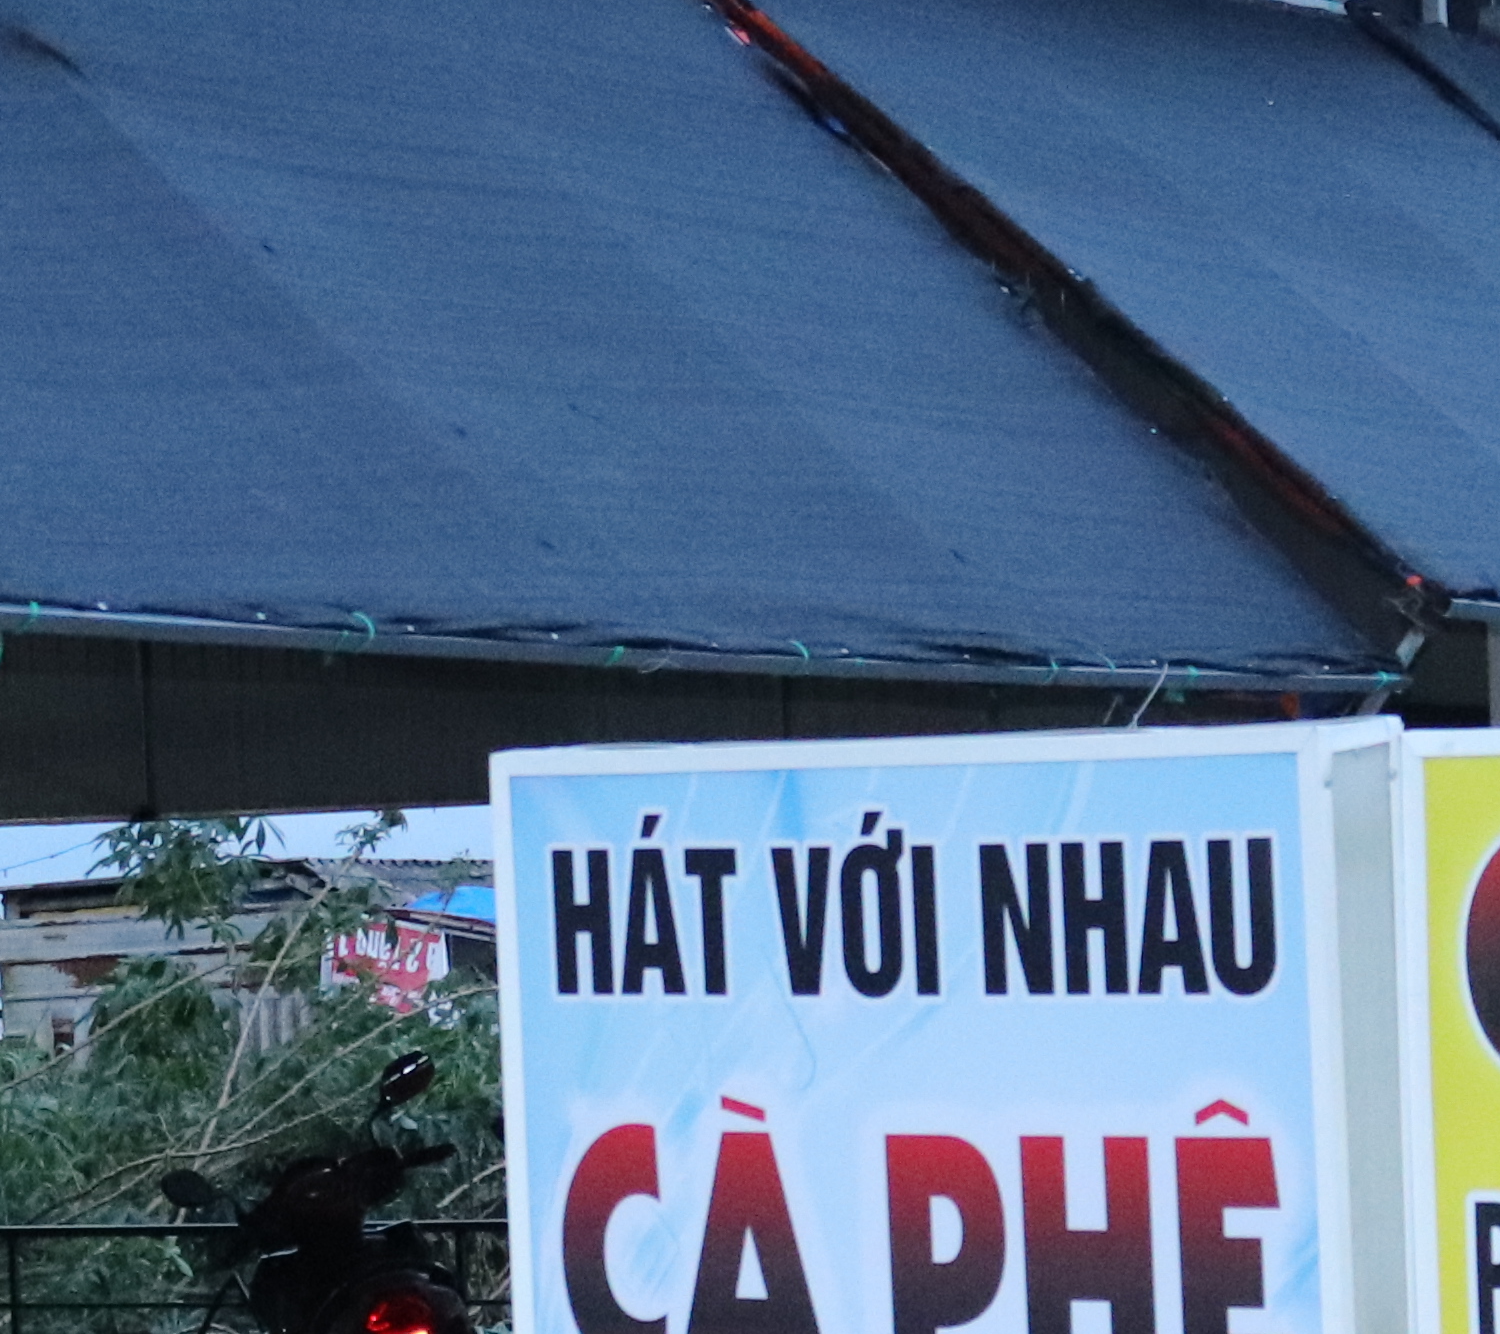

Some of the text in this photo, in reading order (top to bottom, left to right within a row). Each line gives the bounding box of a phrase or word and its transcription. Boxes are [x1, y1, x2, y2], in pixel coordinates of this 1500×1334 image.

[551, 810, 1278, 997] HÁT VỚI NHAU
